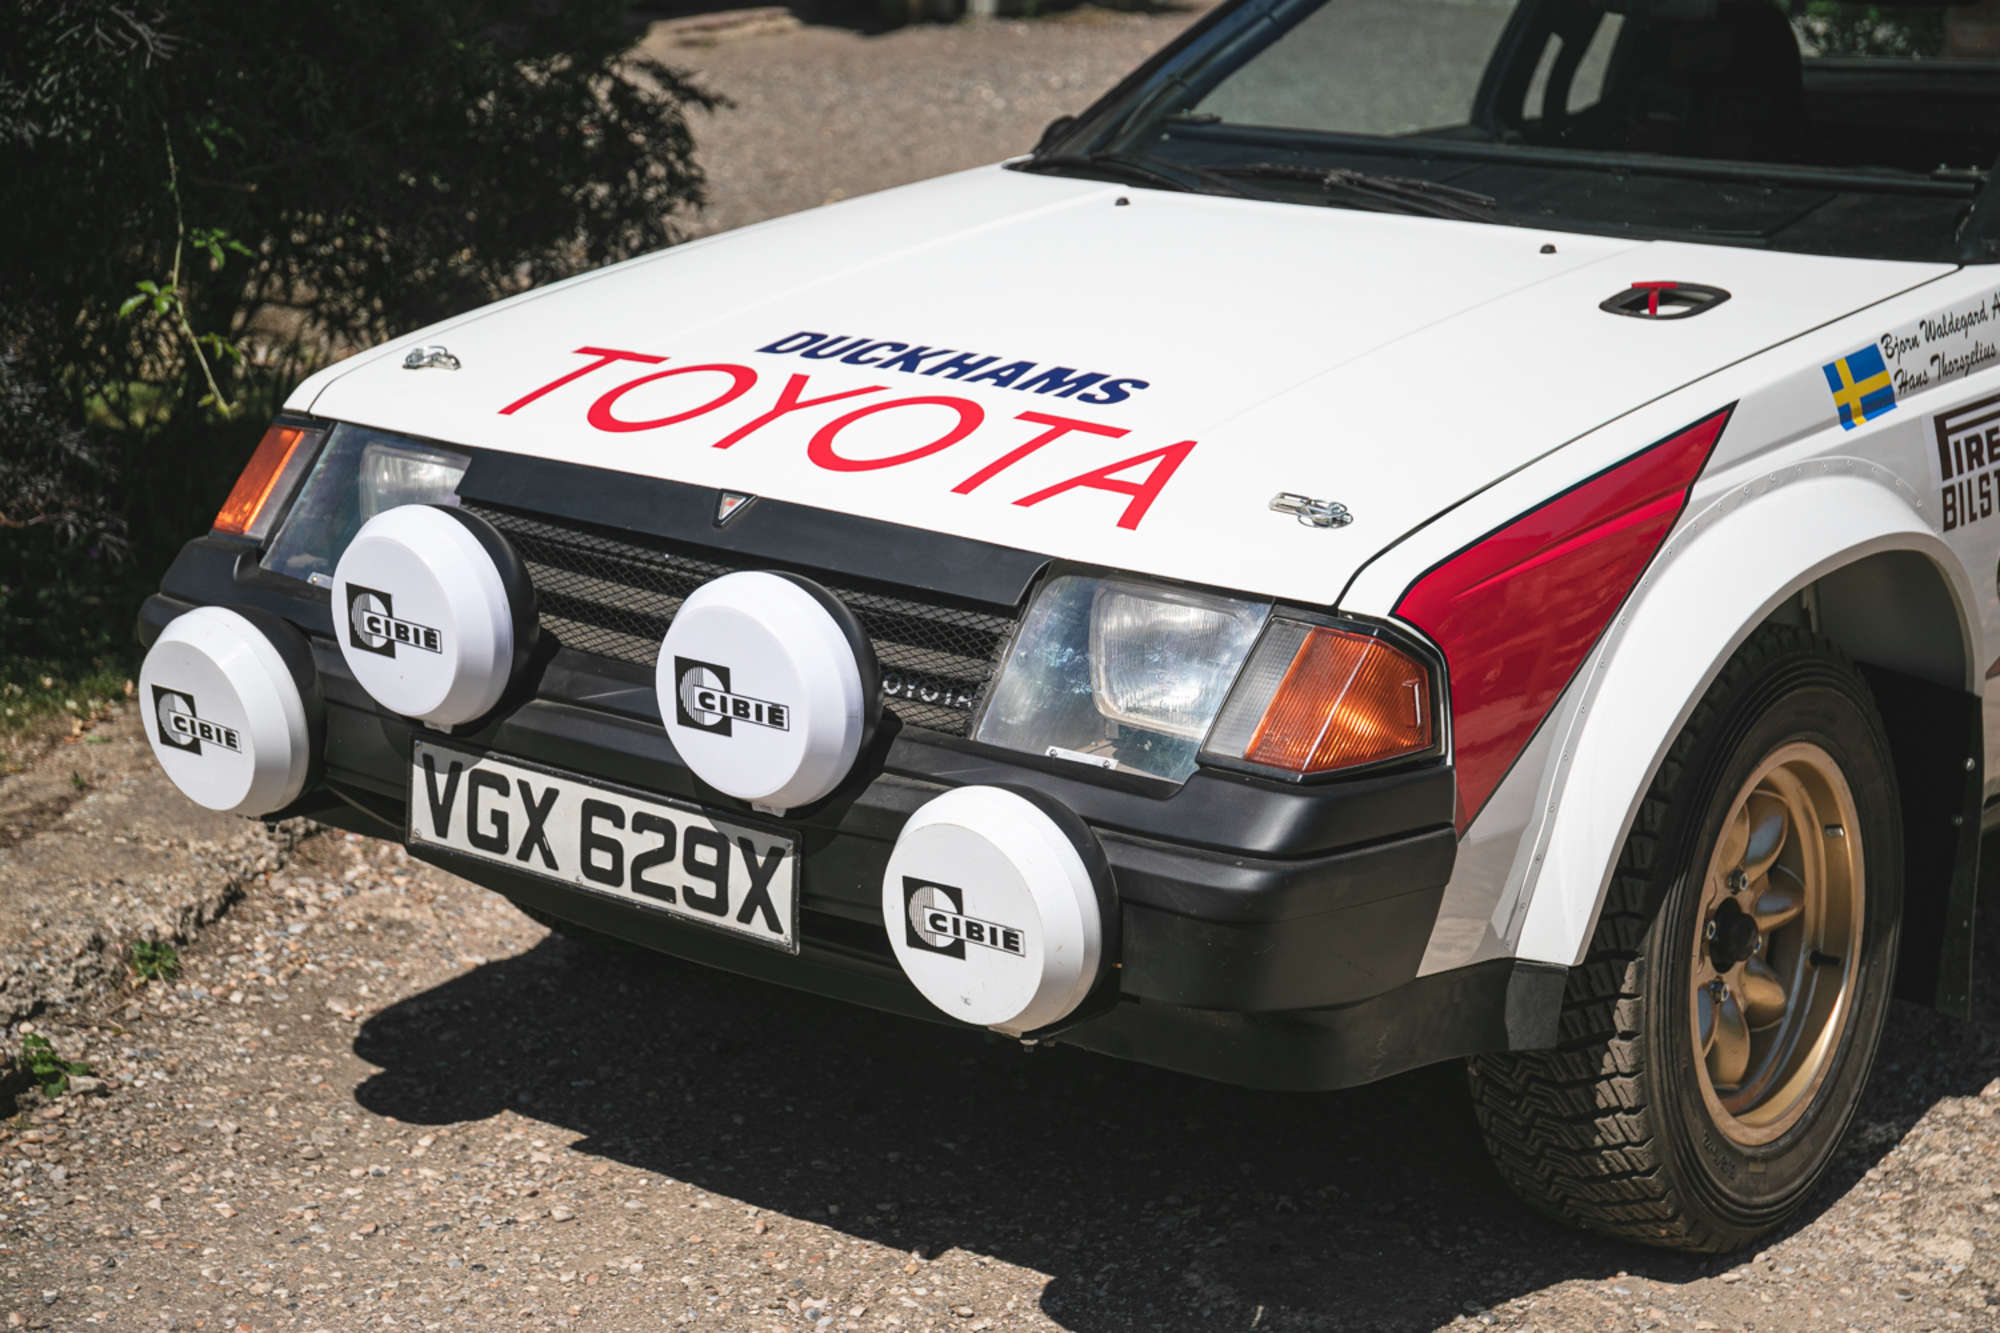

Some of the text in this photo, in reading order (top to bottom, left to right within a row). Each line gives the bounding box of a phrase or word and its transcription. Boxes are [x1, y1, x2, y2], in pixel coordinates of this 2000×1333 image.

[1881, 333, 1919, 364] Bjorn
[1919, 299, 1988, 342] Waldegard
[762, 333, 1148, 404] DUCKHAMS
[1894, 368, 1929, 395] Hans
[499, 347, 1196, 530] TOYOTA
[422, 753, 787, 935] VGX 629X
